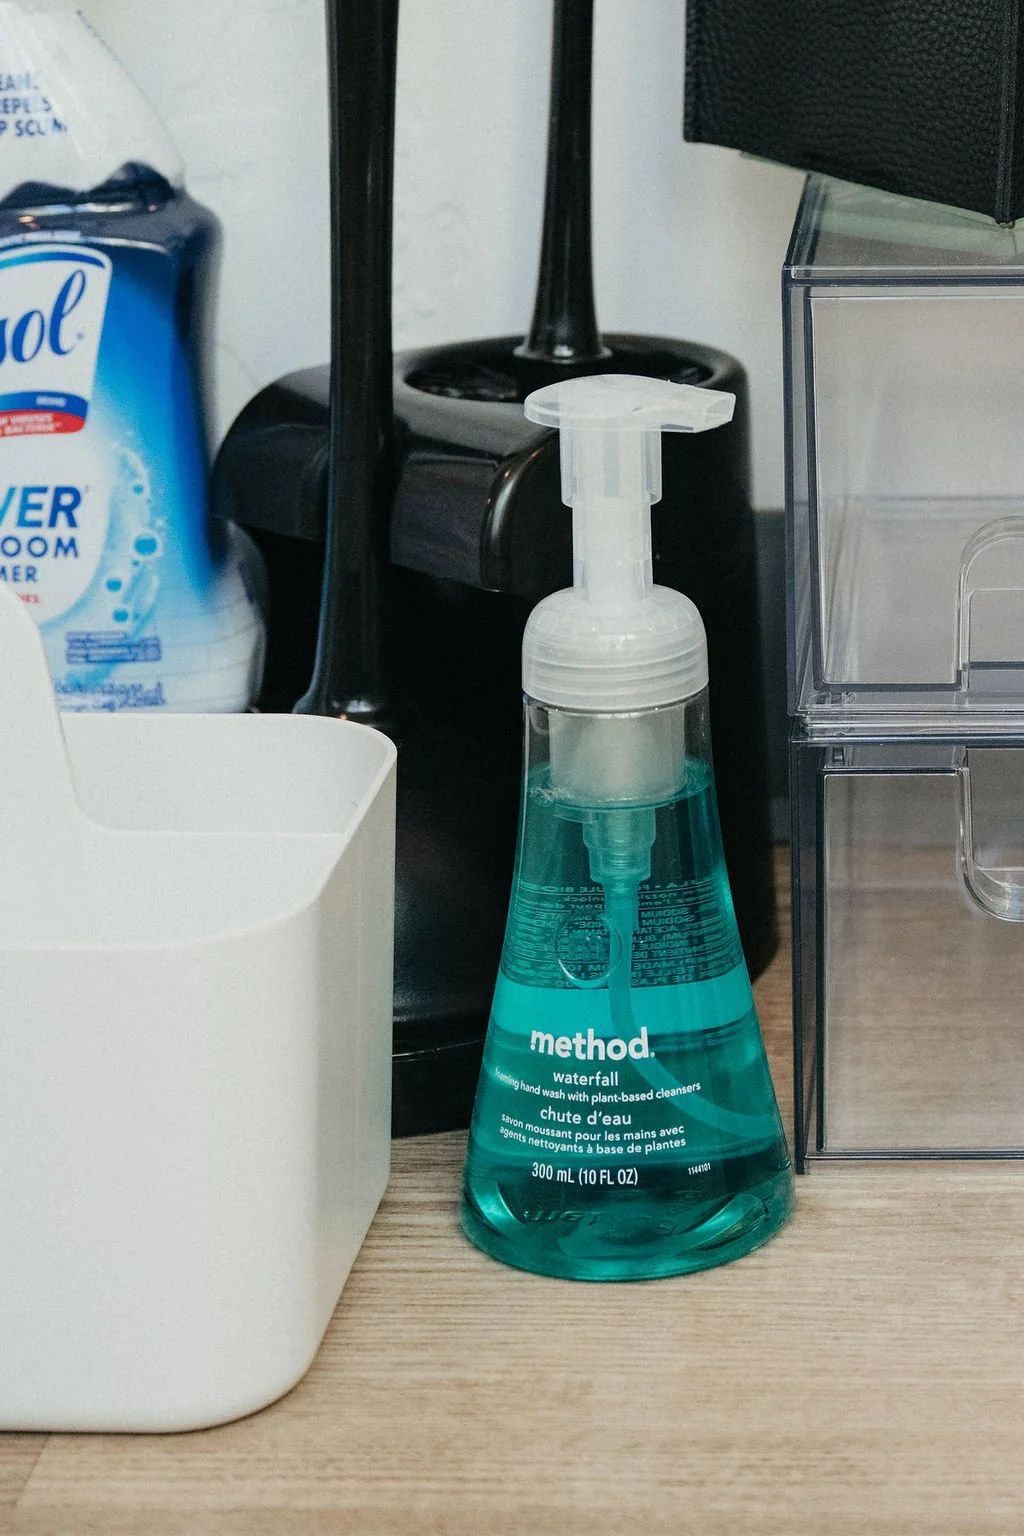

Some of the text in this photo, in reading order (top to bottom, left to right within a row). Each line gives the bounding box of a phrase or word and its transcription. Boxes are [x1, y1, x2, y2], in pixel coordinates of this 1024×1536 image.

[530, 1026, 650, 1060] method
[553, 1071, 618, 1086] waterfall
[520, 1080, 541, 1095] hand
[542, 1089, 565, 1100] wash
[567, 1091, 589, 1102] with
[591, 1089, 653, 1105] plant-based
[656, 1082, 701, 1099] cleansers
[540, 1105, 581, 1124] chute
[500, 1126, 687, 1155] agents nettoyants à base de plantes
[501, 1114, 685, 1142] savon moussant pour les mains avec
[532, 1162, 639, 1186] 300 mL (10 FL OZ)
